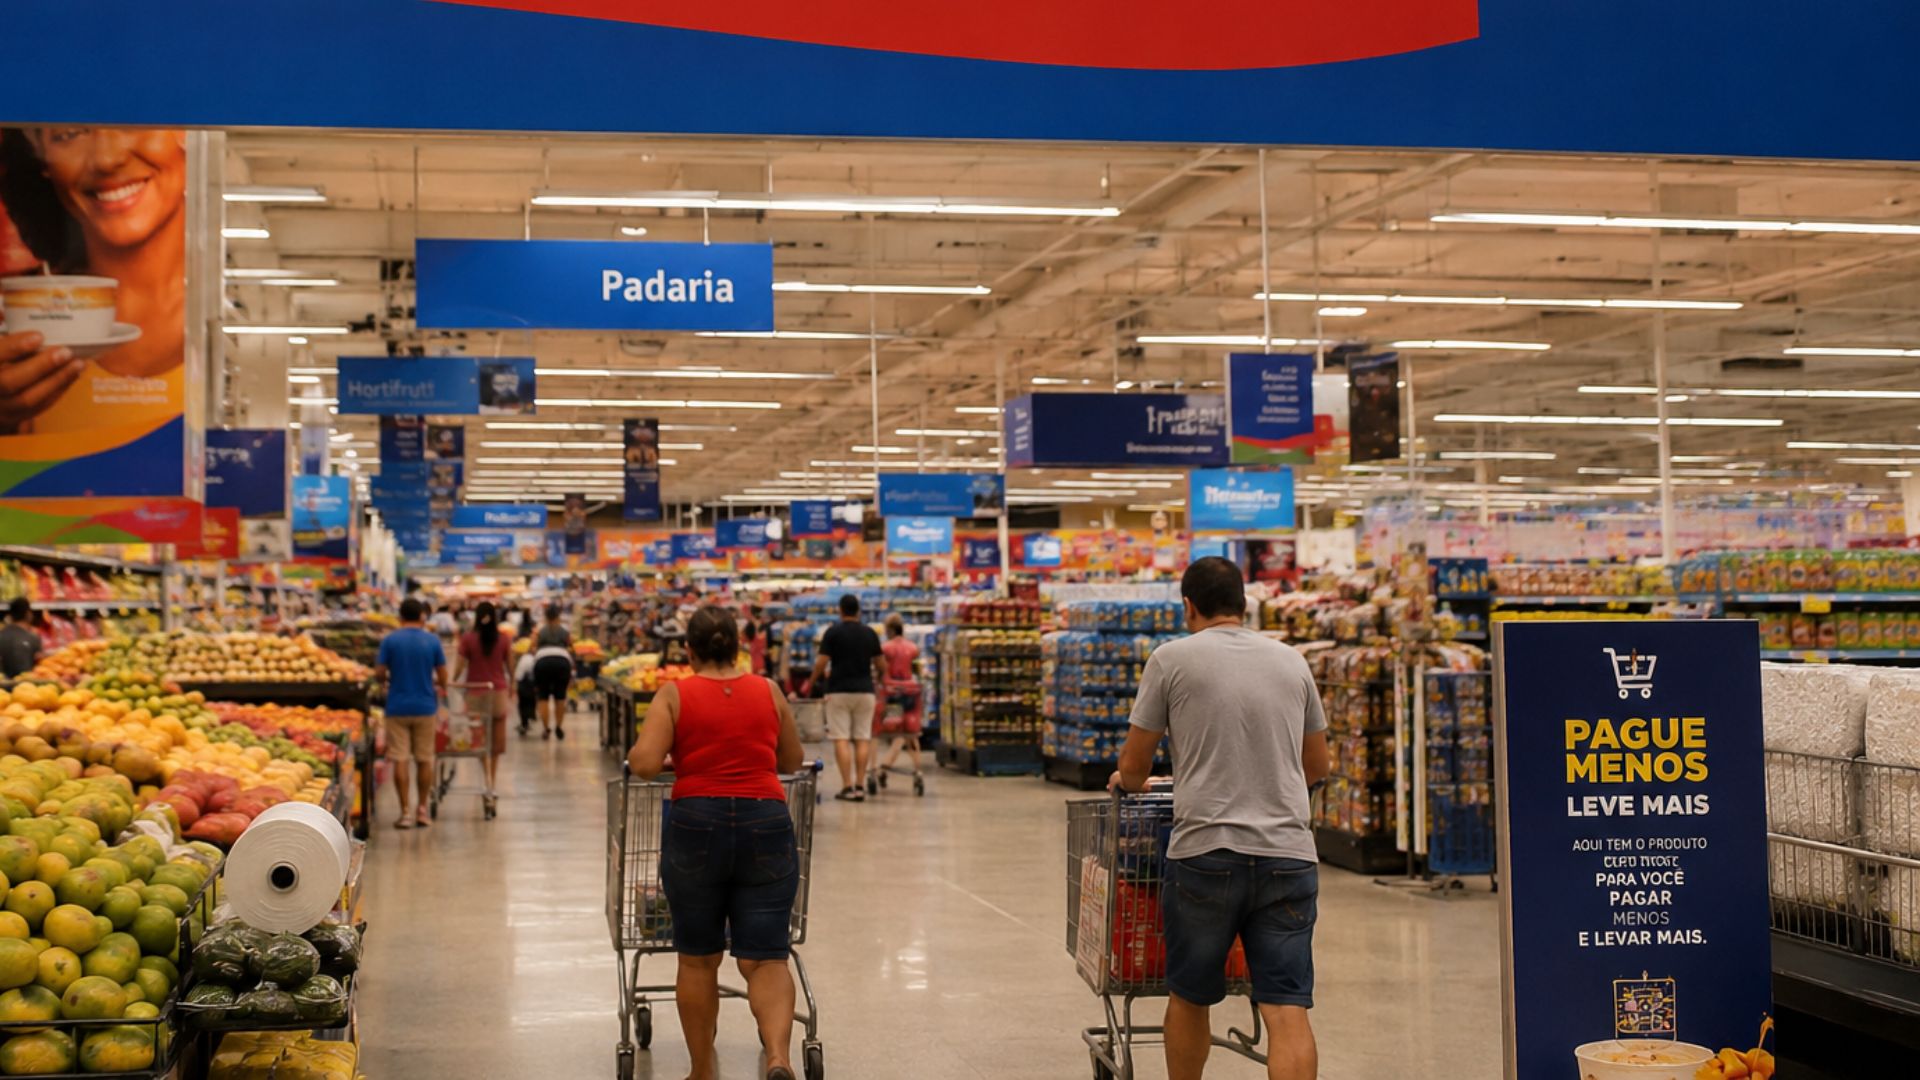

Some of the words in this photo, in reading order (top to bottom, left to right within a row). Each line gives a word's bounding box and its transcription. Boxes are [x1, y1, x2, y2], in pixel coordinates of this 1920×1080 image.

[602, 269, 734, 302] Padaria
[1564, 717, 1707, 750] PAGUE
[1566, 751, 1709, 783] MENOS
[1567, 795, 1635, 817] LEVE
[1642, 794, 1710, 816] MAIS
[1572, 839, 1602, 851] AQUI
[1606, 838, 1632, 851] TEM
[1635, 838, 1645, 850] O
[1648, 837, 1707, 850] PRODUTO
[1595, 872, 1637, 887] PARA
[1640, 867, 1684, 886] VOCÊ
[1609, 890, 1672, 906] PAGAR
[1613, 911, 1670, 926] MENOS
[1578, 931, 1589, 946] E
[1595, 930, 1652, 946] LEVAR
[1657, 929, 1707, 945] MAIS.
